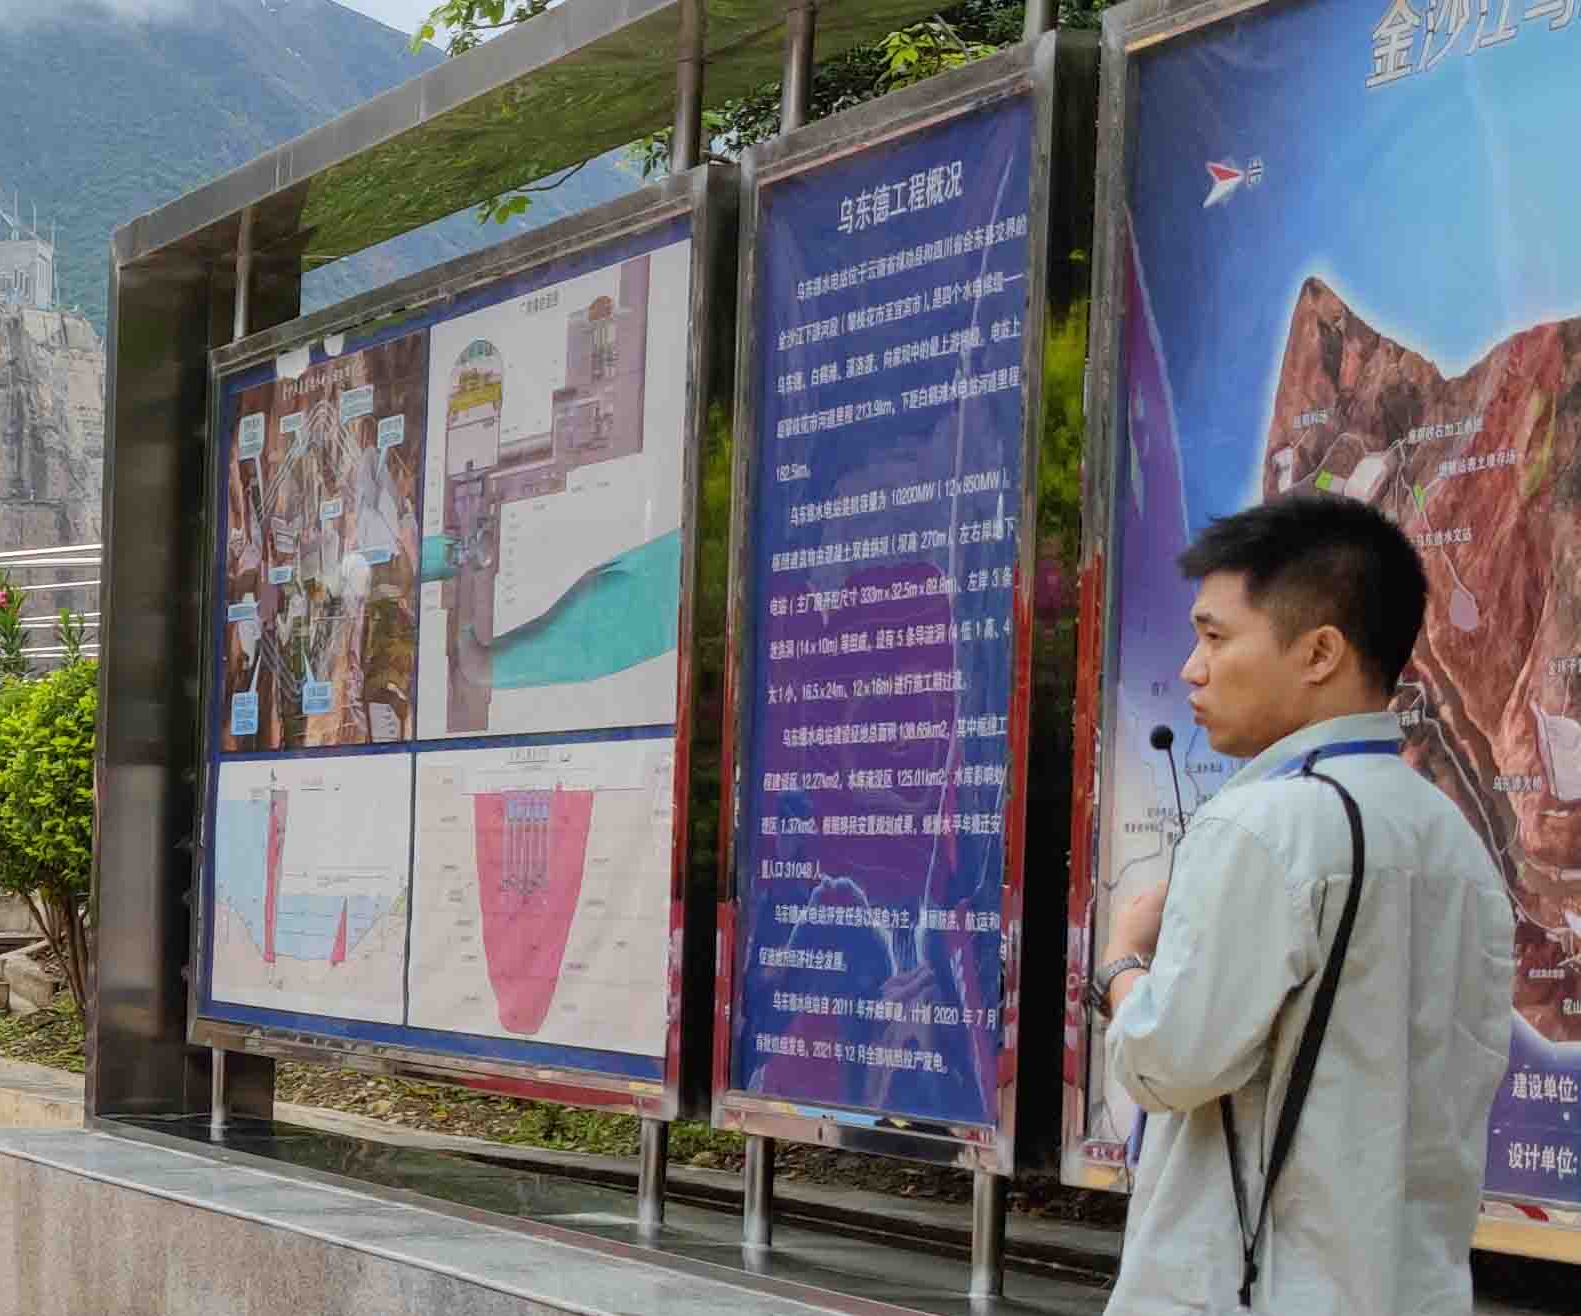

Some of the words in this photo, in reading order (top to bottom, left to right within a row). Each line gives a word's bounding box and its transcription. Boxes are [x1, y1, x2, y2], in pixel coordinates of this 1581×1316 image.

[837, 161, 963, 234] 乌东德工程概况
